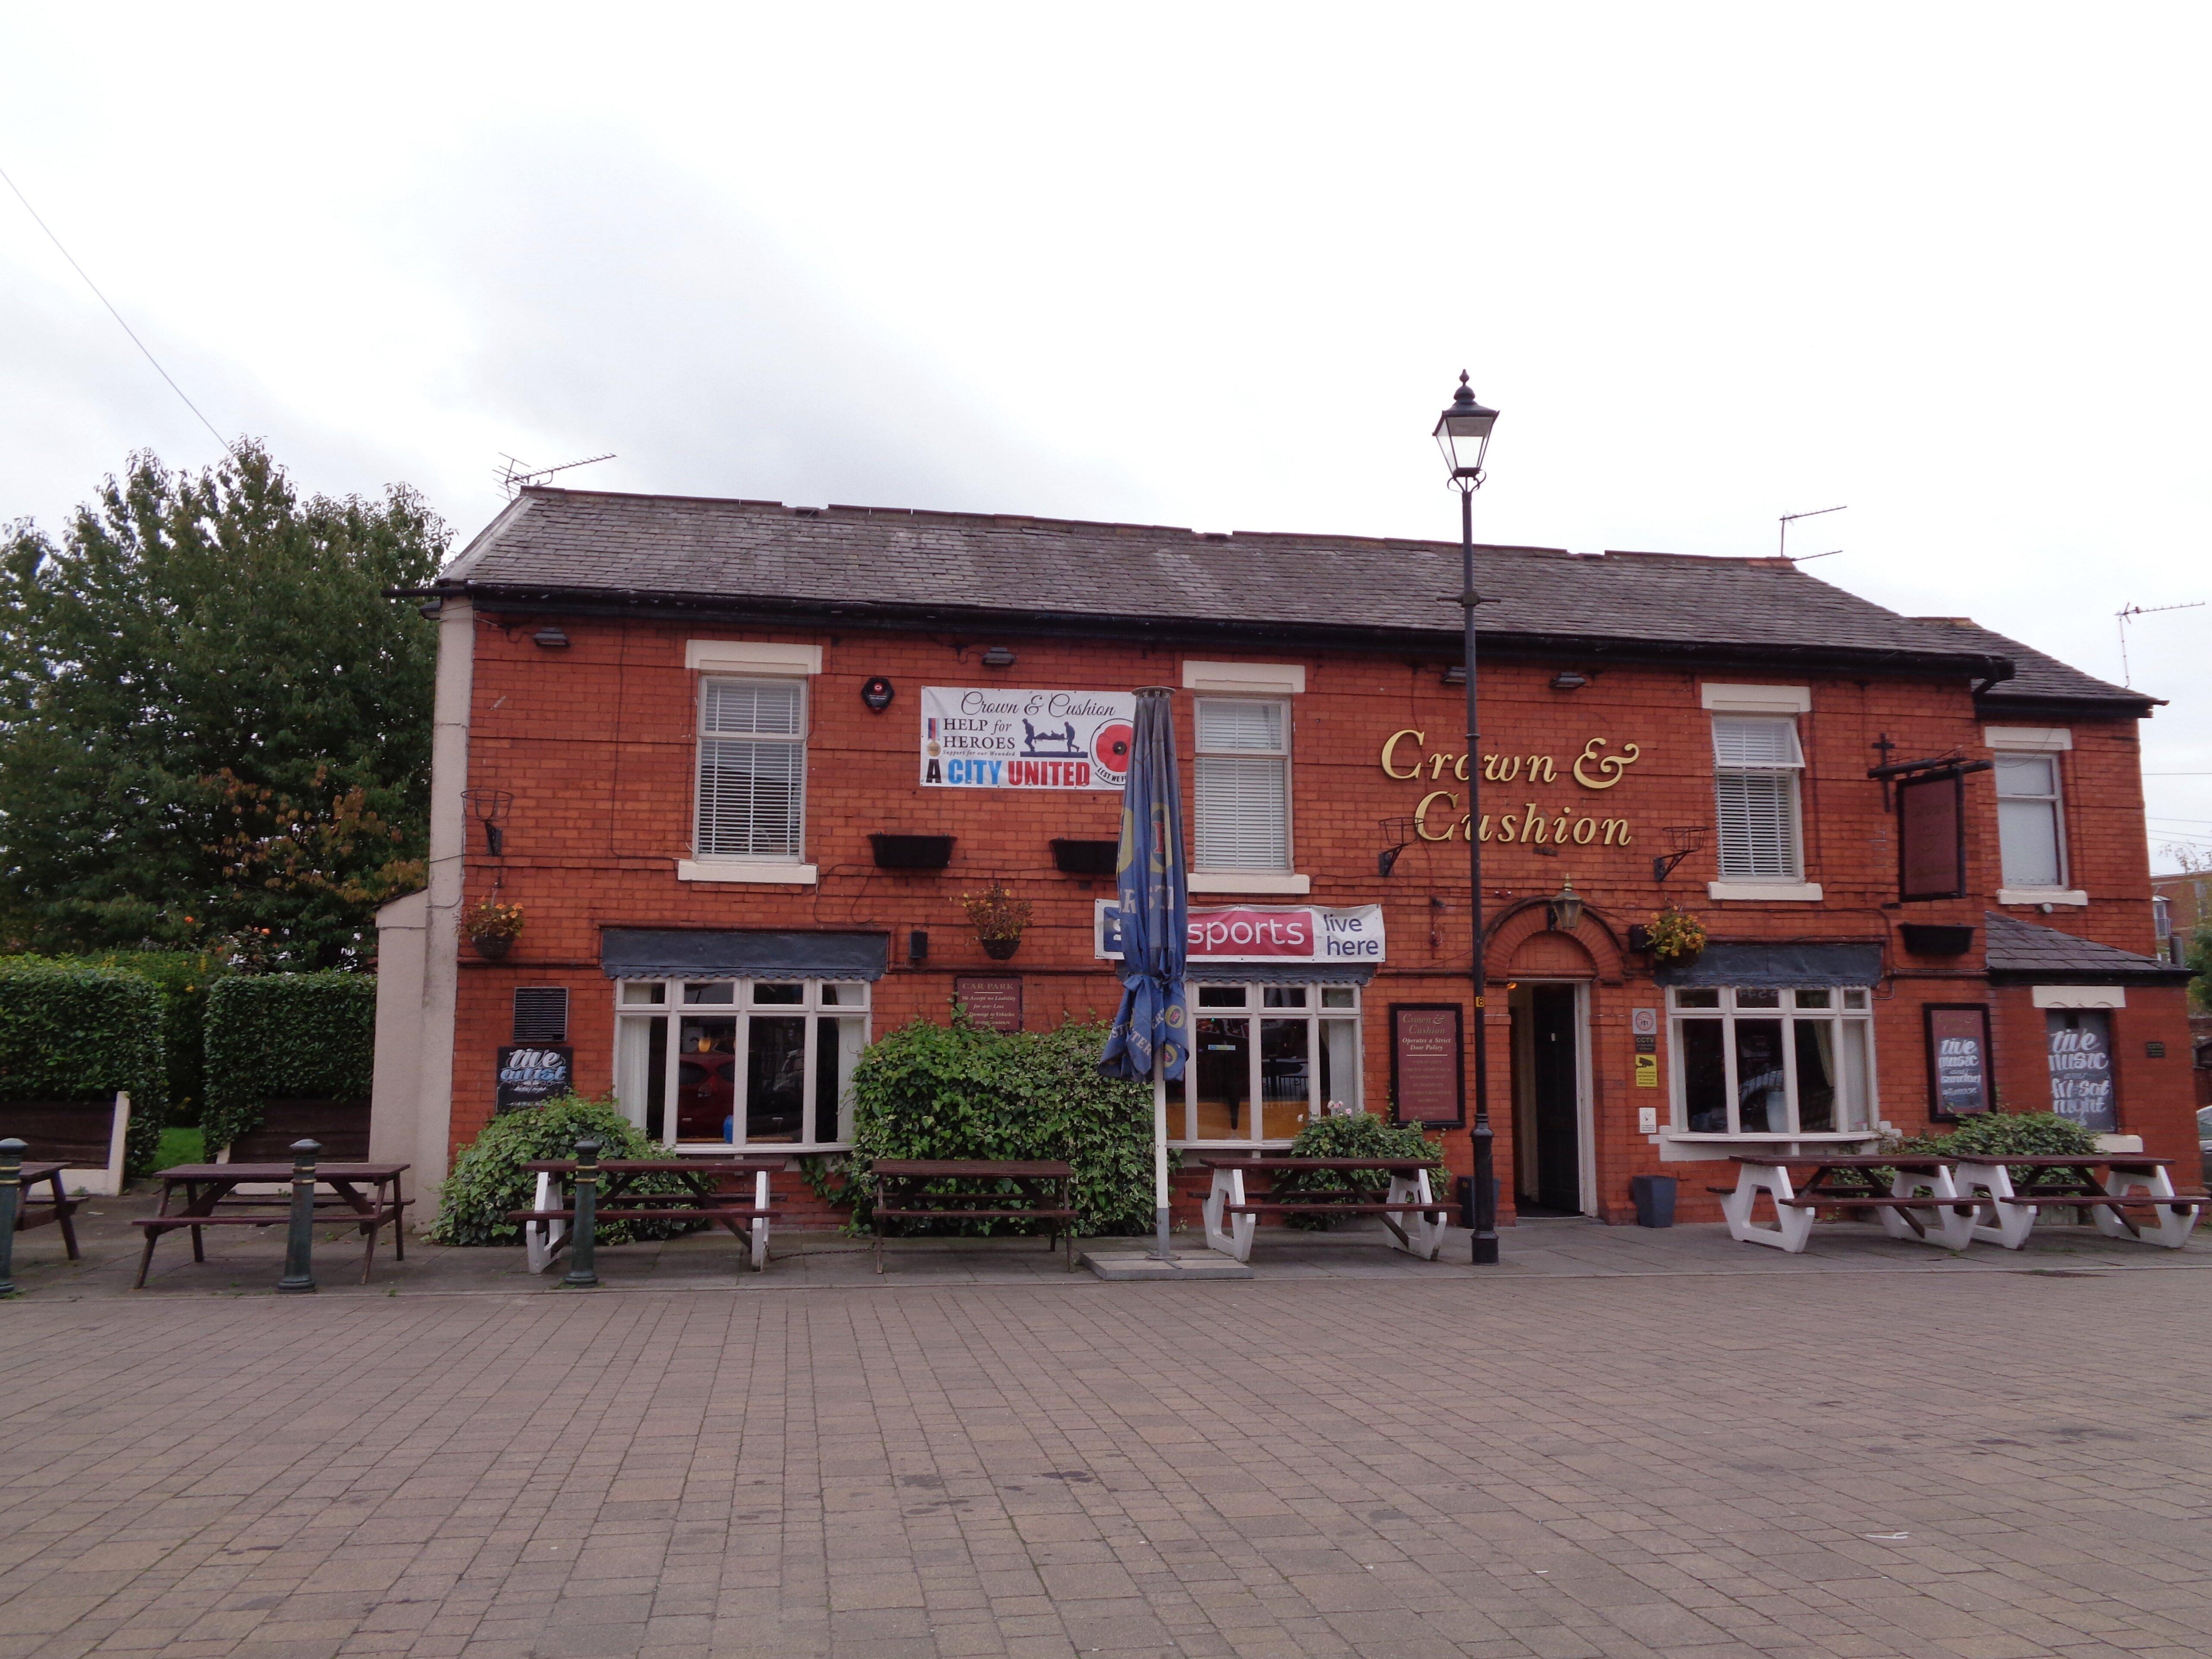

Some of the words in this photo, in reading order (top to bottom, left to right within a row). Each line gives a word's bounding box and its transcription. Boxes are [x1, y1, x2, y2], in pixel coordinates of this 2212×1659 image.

[961, 691, 1019, 715] Crown
[1024, 695, 1043, 715] &
[1048, 692, 1116, 717] Cushion
[943, 718, 988, 731] HELP
[991, 720, 1012, 735] for
[943, 736, 1015, 749] HEROES
[1381, 729, 1557, 782] Crown
[1573, 738, 1639, 789] &
[926, 758, 942, 783] A
[949, 758, 1002, 785] CITY
[1008, 760, 1090, 786] UNITED
[1097, 767, 1111, 779] LEST
[1414, 791, 1632, 846] Cushion
[1323, 914, 1363, 933] live
[1187, 918, 1305, 951] sports
[1327, 935, 1379, 956] here
[1478, 997, 1483, 1006] 8
[1403, 1014, 1431, 1023] Crown
[1433, 1015, 1445, 1024] &
[1409, 1024, 1445, 1034] Cushion
[1941, 1038, 1978, 1055] live
[2050, 1028, 2100, 1053] live
[509, 1048, 563, 1069] live
[1939, 1055, 1979, 1068] music
[2048, 1052, 2108, 1071] music
[500, 1066, 567, 1081] artist
[2054, 1097, 2107, 1119] night
